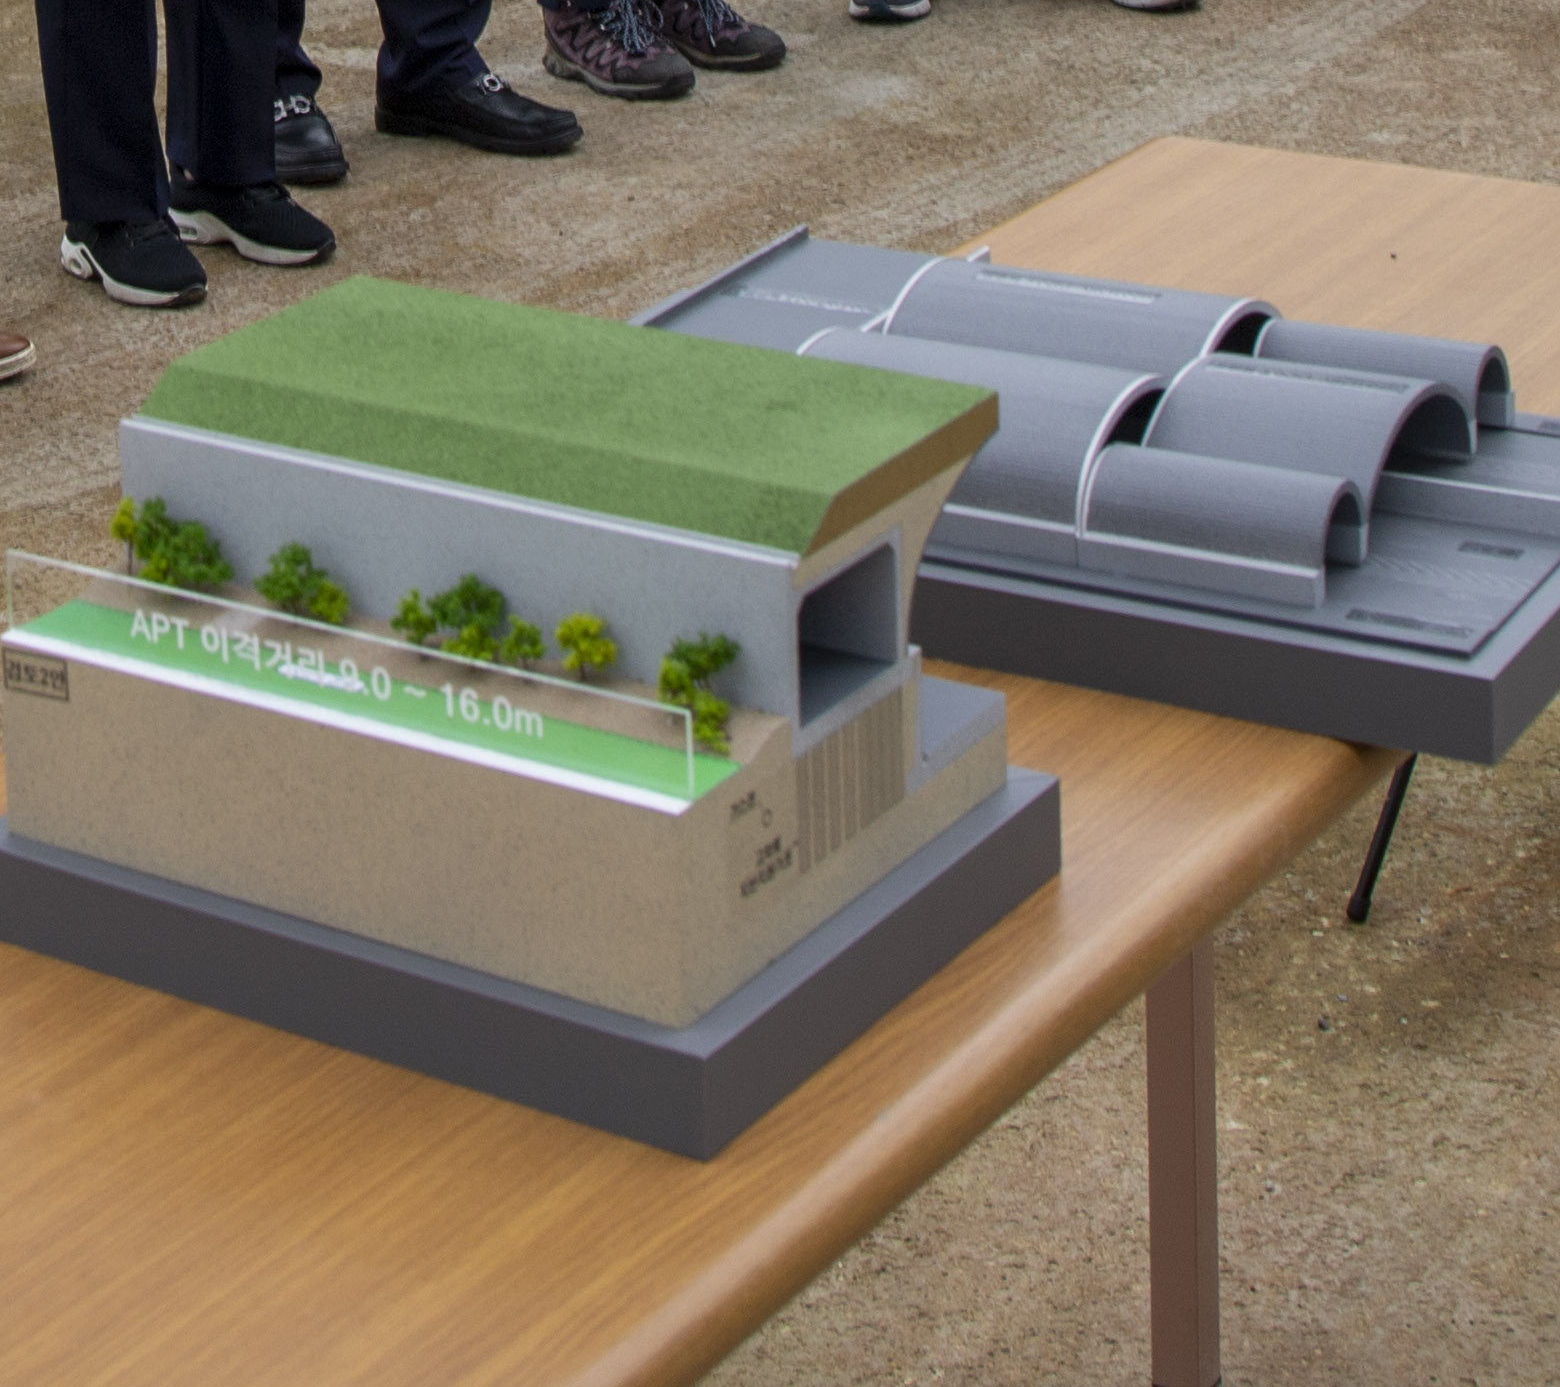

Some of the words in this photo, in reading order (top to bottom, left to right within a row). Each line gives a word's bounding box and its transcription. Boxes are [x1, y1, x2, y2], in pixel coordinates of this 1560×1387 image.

[130, 608, 189, 650] APT
[200, 623, 327, 687] 이격거리
[440, 682, 544, 739] 16.0m
